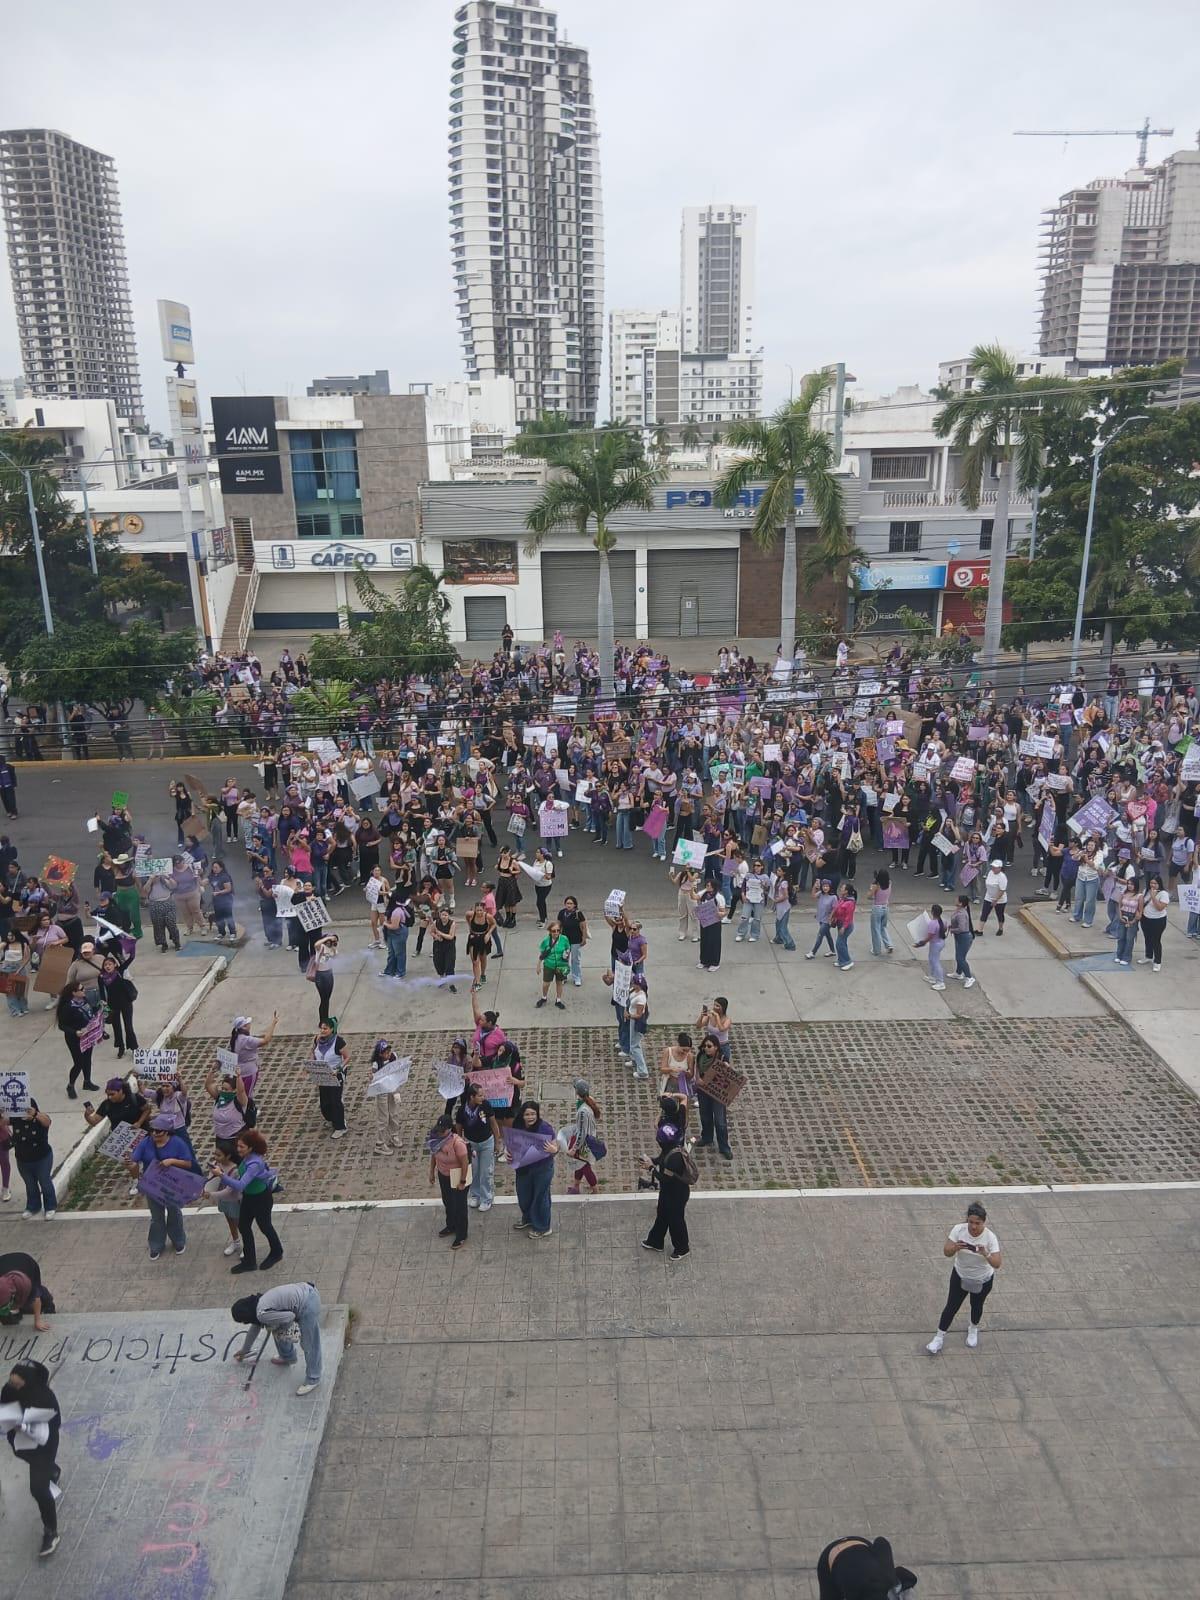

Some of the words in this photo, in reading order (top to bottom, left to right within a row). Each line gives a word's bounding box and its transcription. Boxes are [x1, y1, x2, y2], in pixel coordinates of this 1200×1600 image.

[225, 427, 268, 445] 4AM
[311, 552, 377, 567] CAPECO
[135, 1049, 150, 1057] SOY
[160, 1057, 176, 1065] NIÑA
